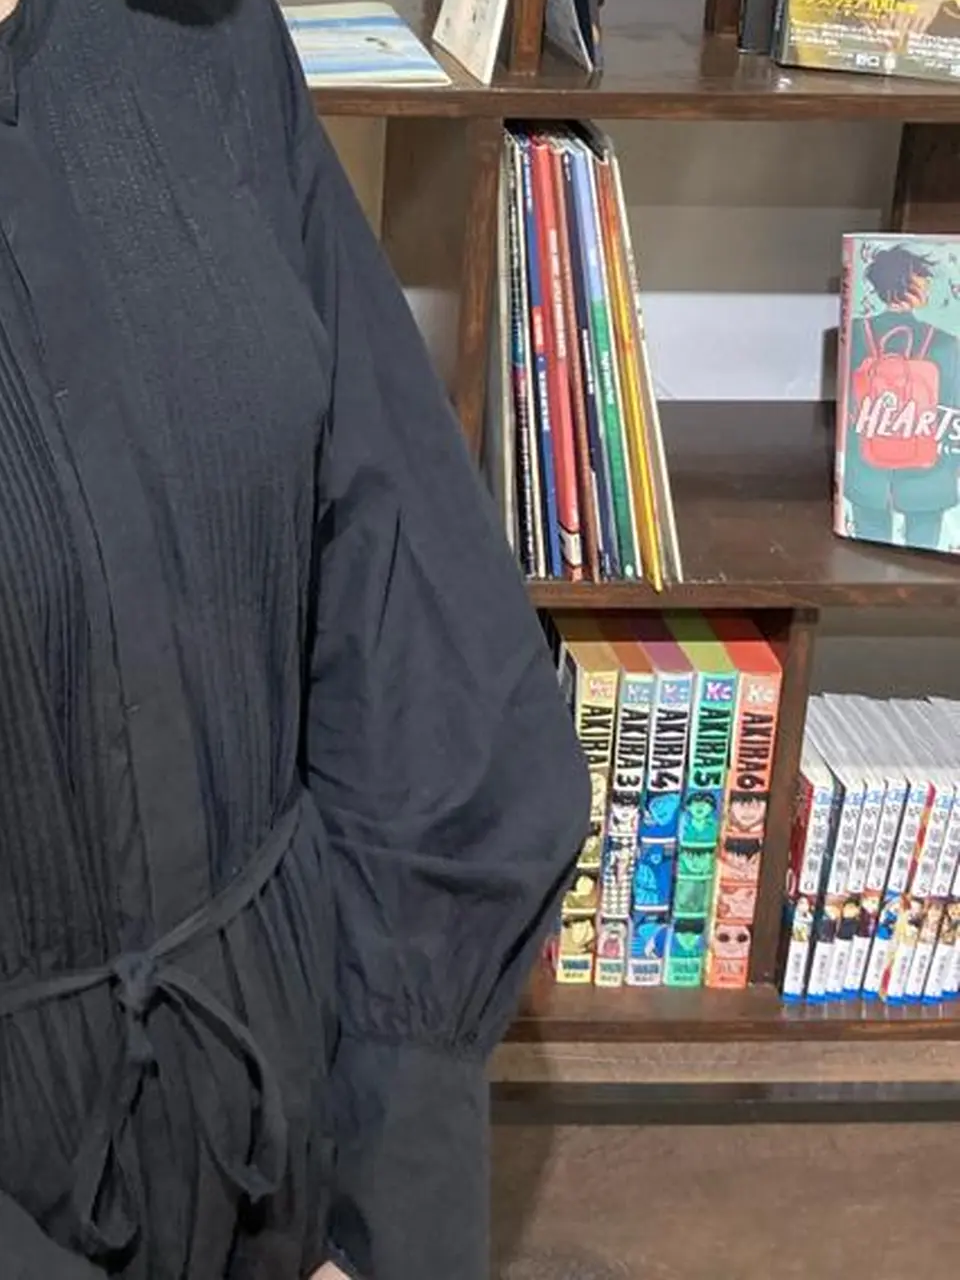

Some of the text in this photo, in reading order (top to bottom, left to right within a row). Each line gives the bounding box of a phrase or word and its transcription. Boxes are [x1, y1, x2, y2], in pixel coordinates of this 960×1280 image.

[580, 704, 613, 765] AKIRA
[617, 708, 650, 787] AKIRA 3
[651, 708, 688, 789] AKIRA 4
[693, 706, 731, 787] AKIRA 5
[736, 712, 774, 789] AKIRA 6
